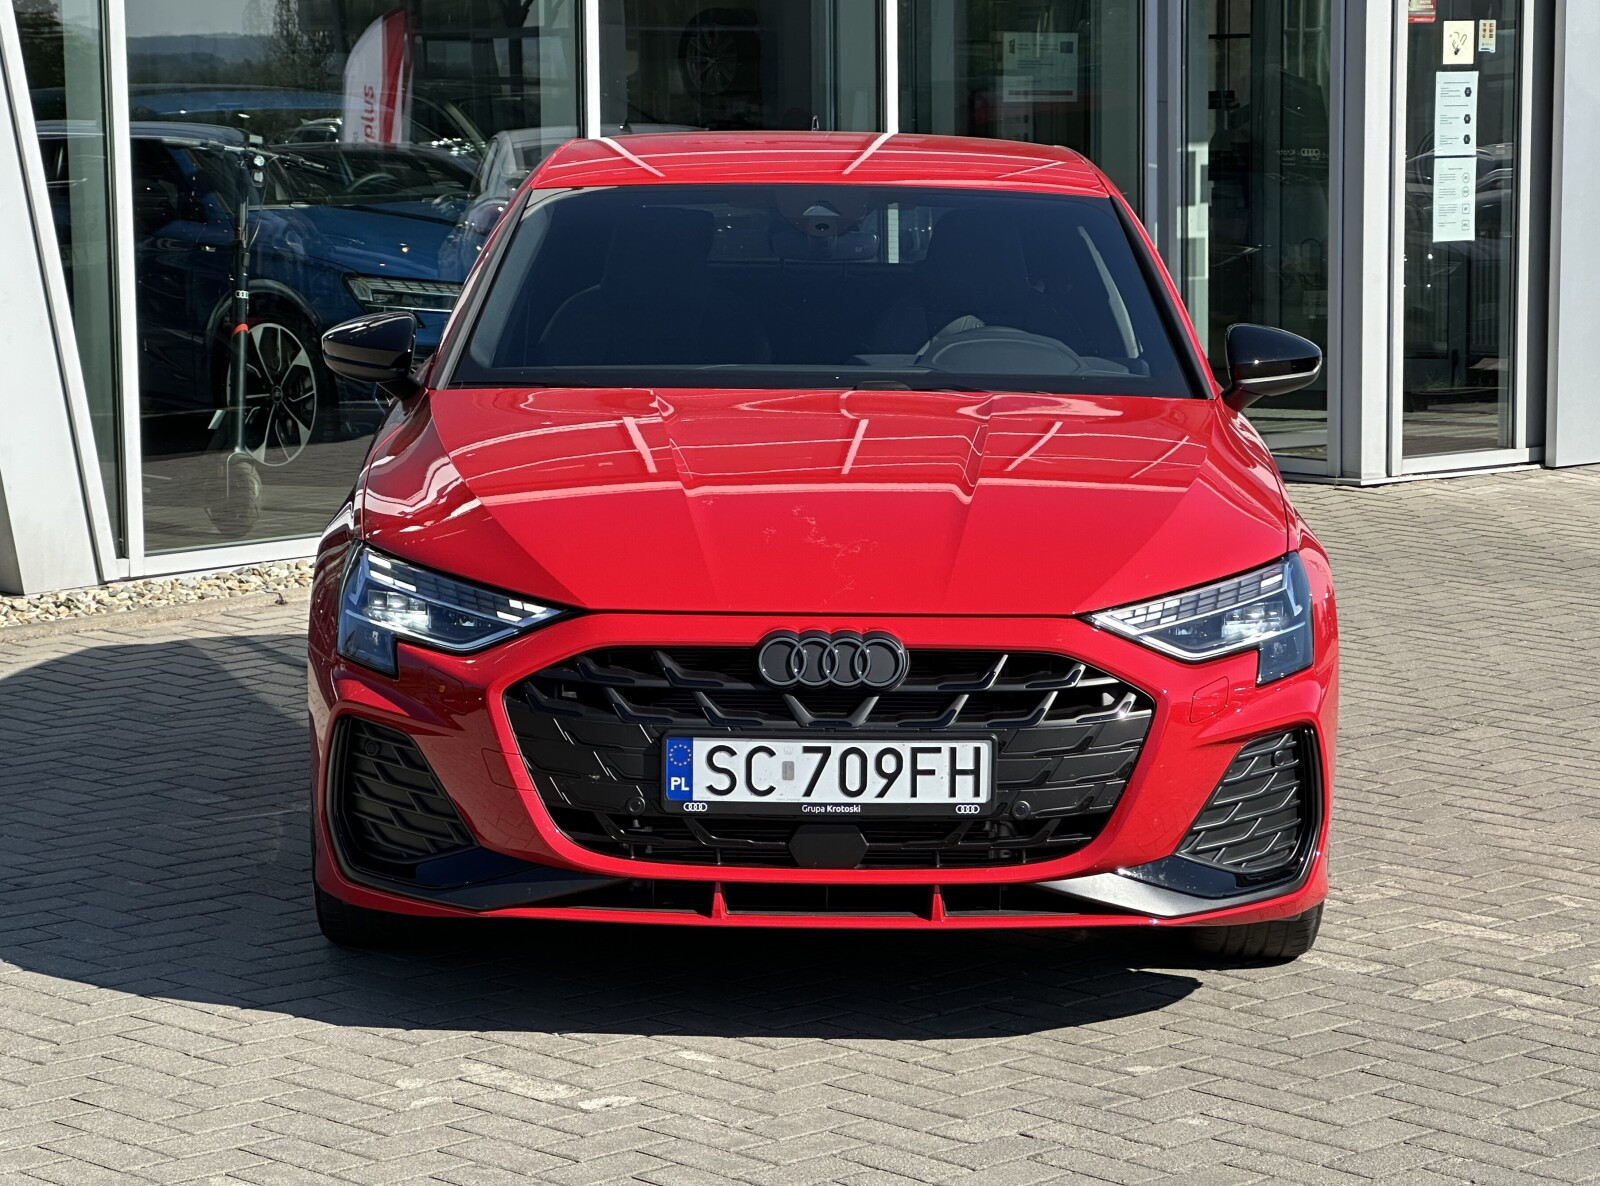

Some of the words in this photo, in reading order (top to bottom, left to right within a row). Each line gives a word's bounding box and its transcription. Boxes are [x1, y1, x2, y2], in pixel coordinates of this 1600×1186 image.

[706, 745, 777, 797] SC
[802, 746, 981, 798] 709FH
[670, 777, 690, 791] PL
[801, 804, 826, 814] Grupa
[826, 804, 861, 813] Krotoski
